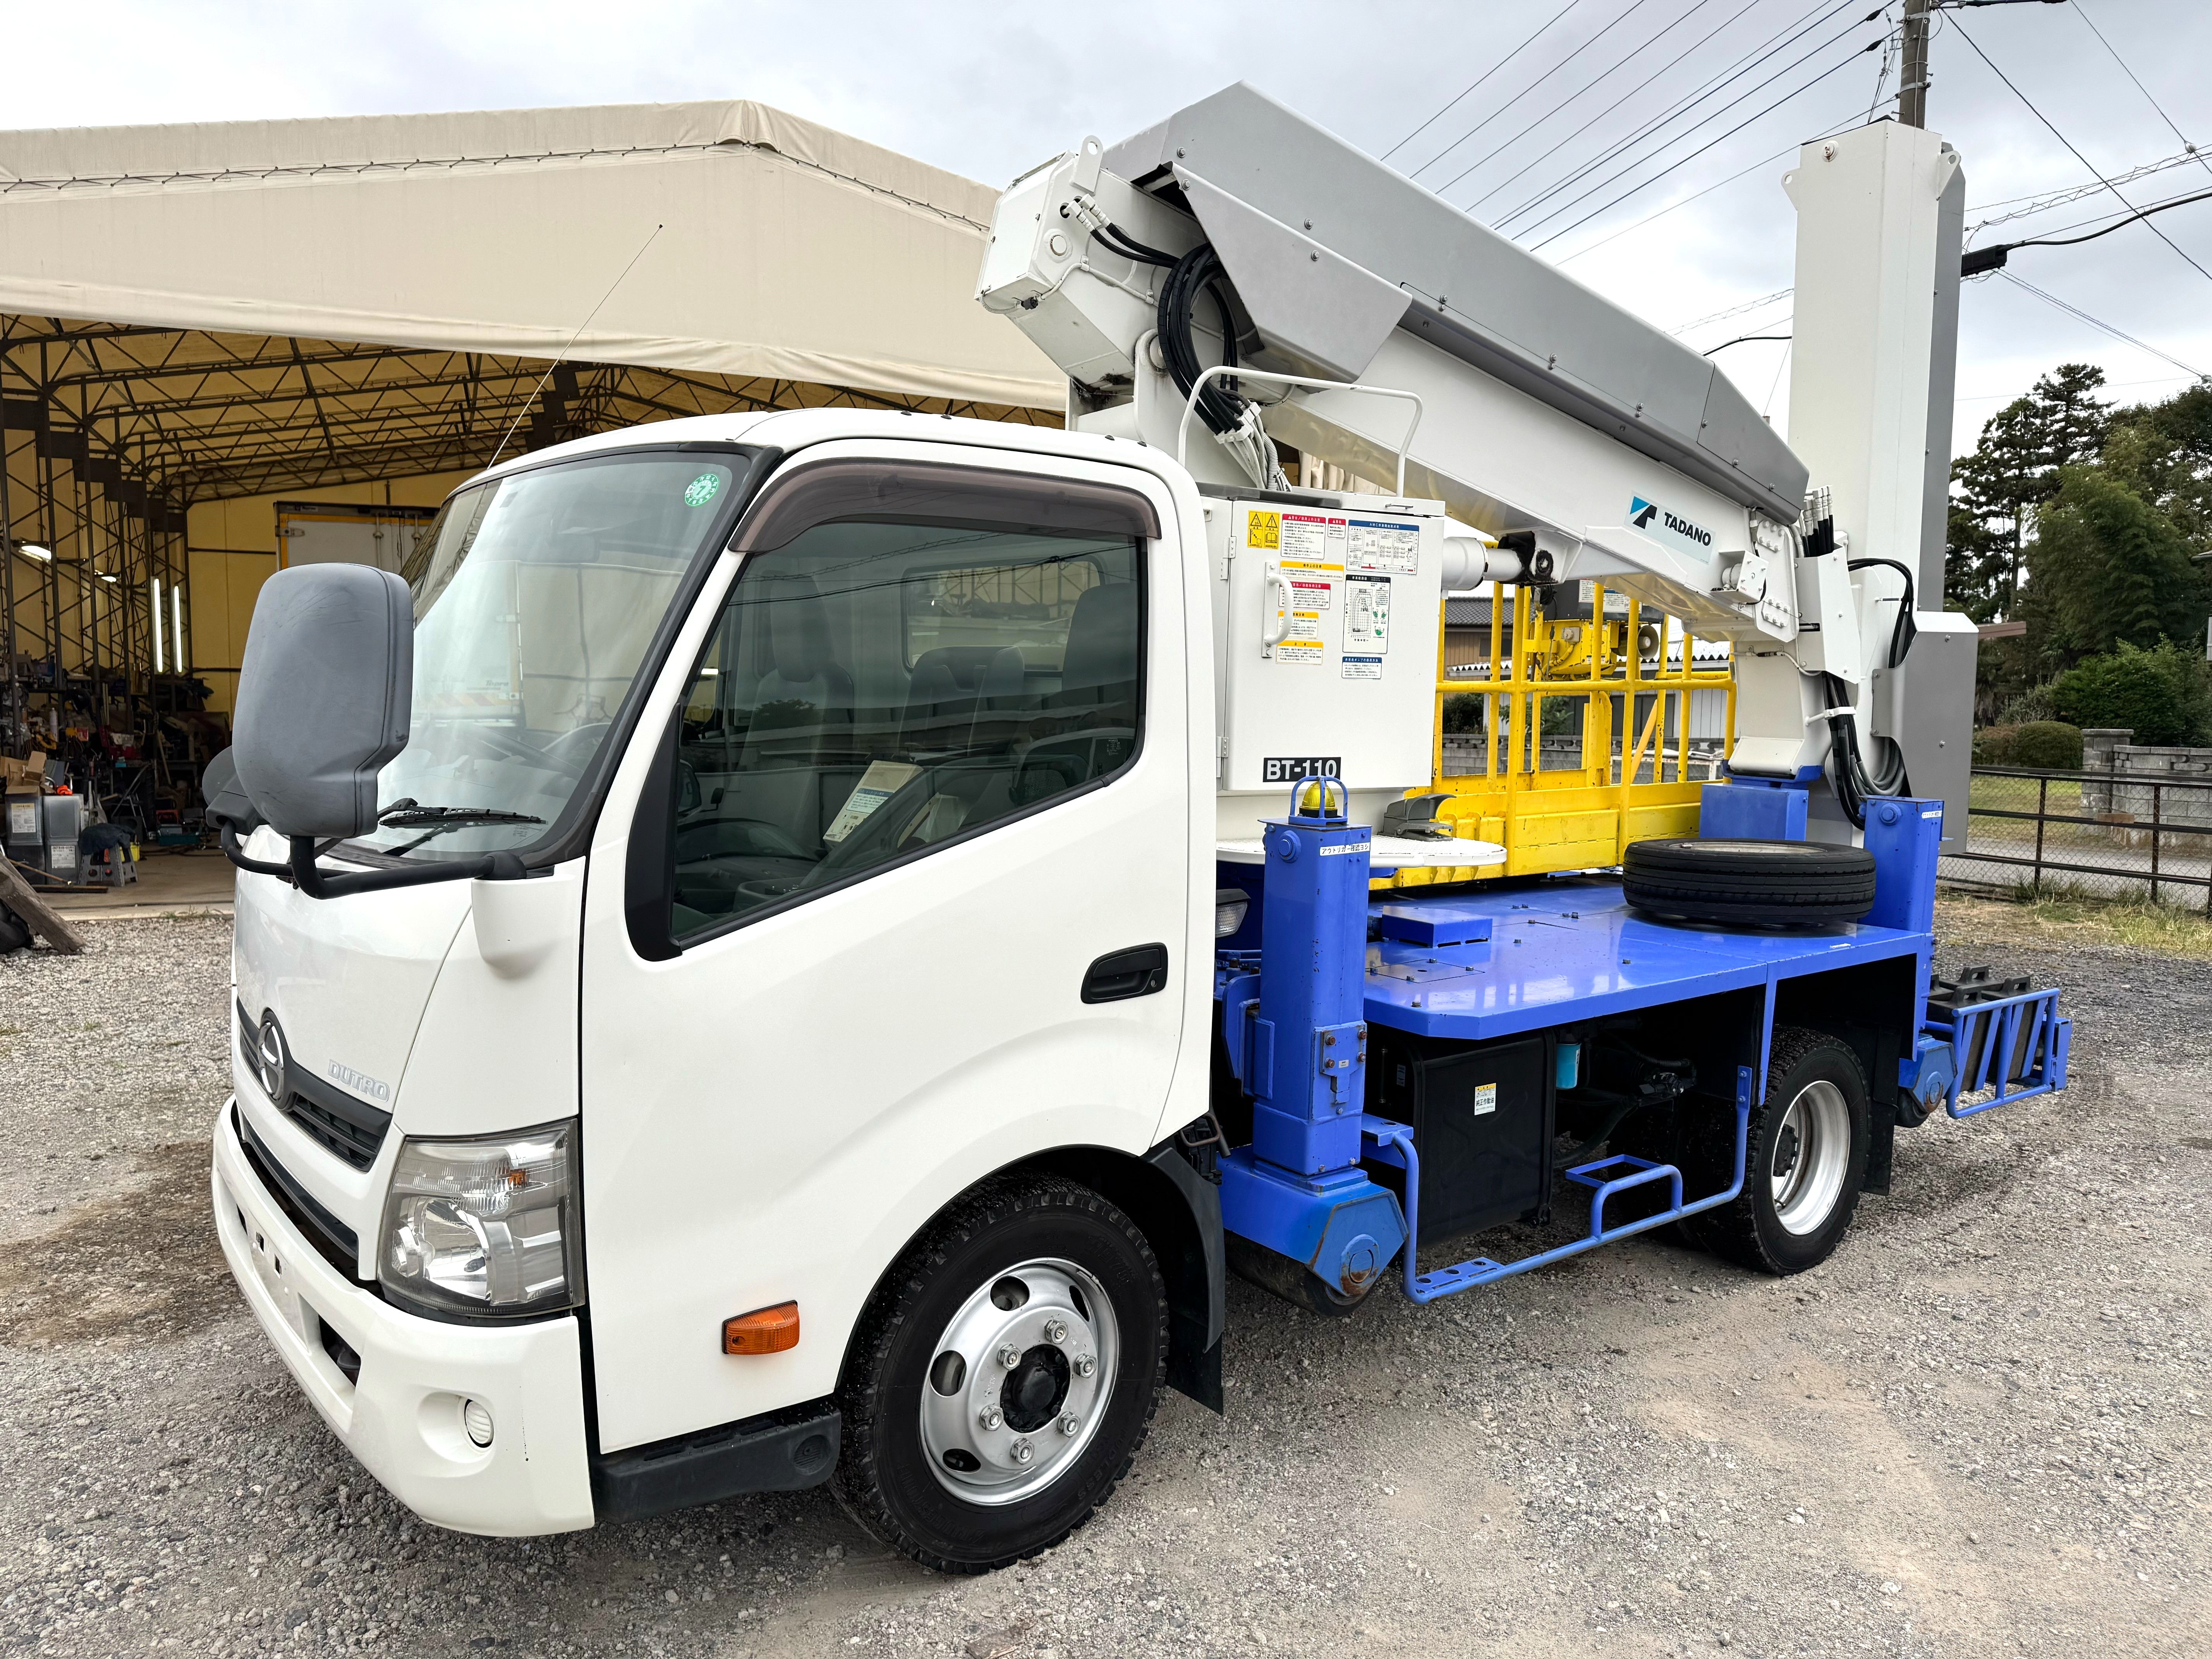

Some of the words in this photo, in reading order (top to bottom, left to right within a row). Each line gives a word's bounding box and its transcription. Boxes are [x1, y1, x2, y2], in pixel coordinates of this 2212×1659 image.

[696, 485, 707, 496] 7
[1664, 512, 1711, 546] TADANO
[1267, 759, 1337, 780] BT-110
[1321, 843, 1369, 854] アウトリガー確認ヨシ
[328, 1058, 390, 1103] DUTRO
